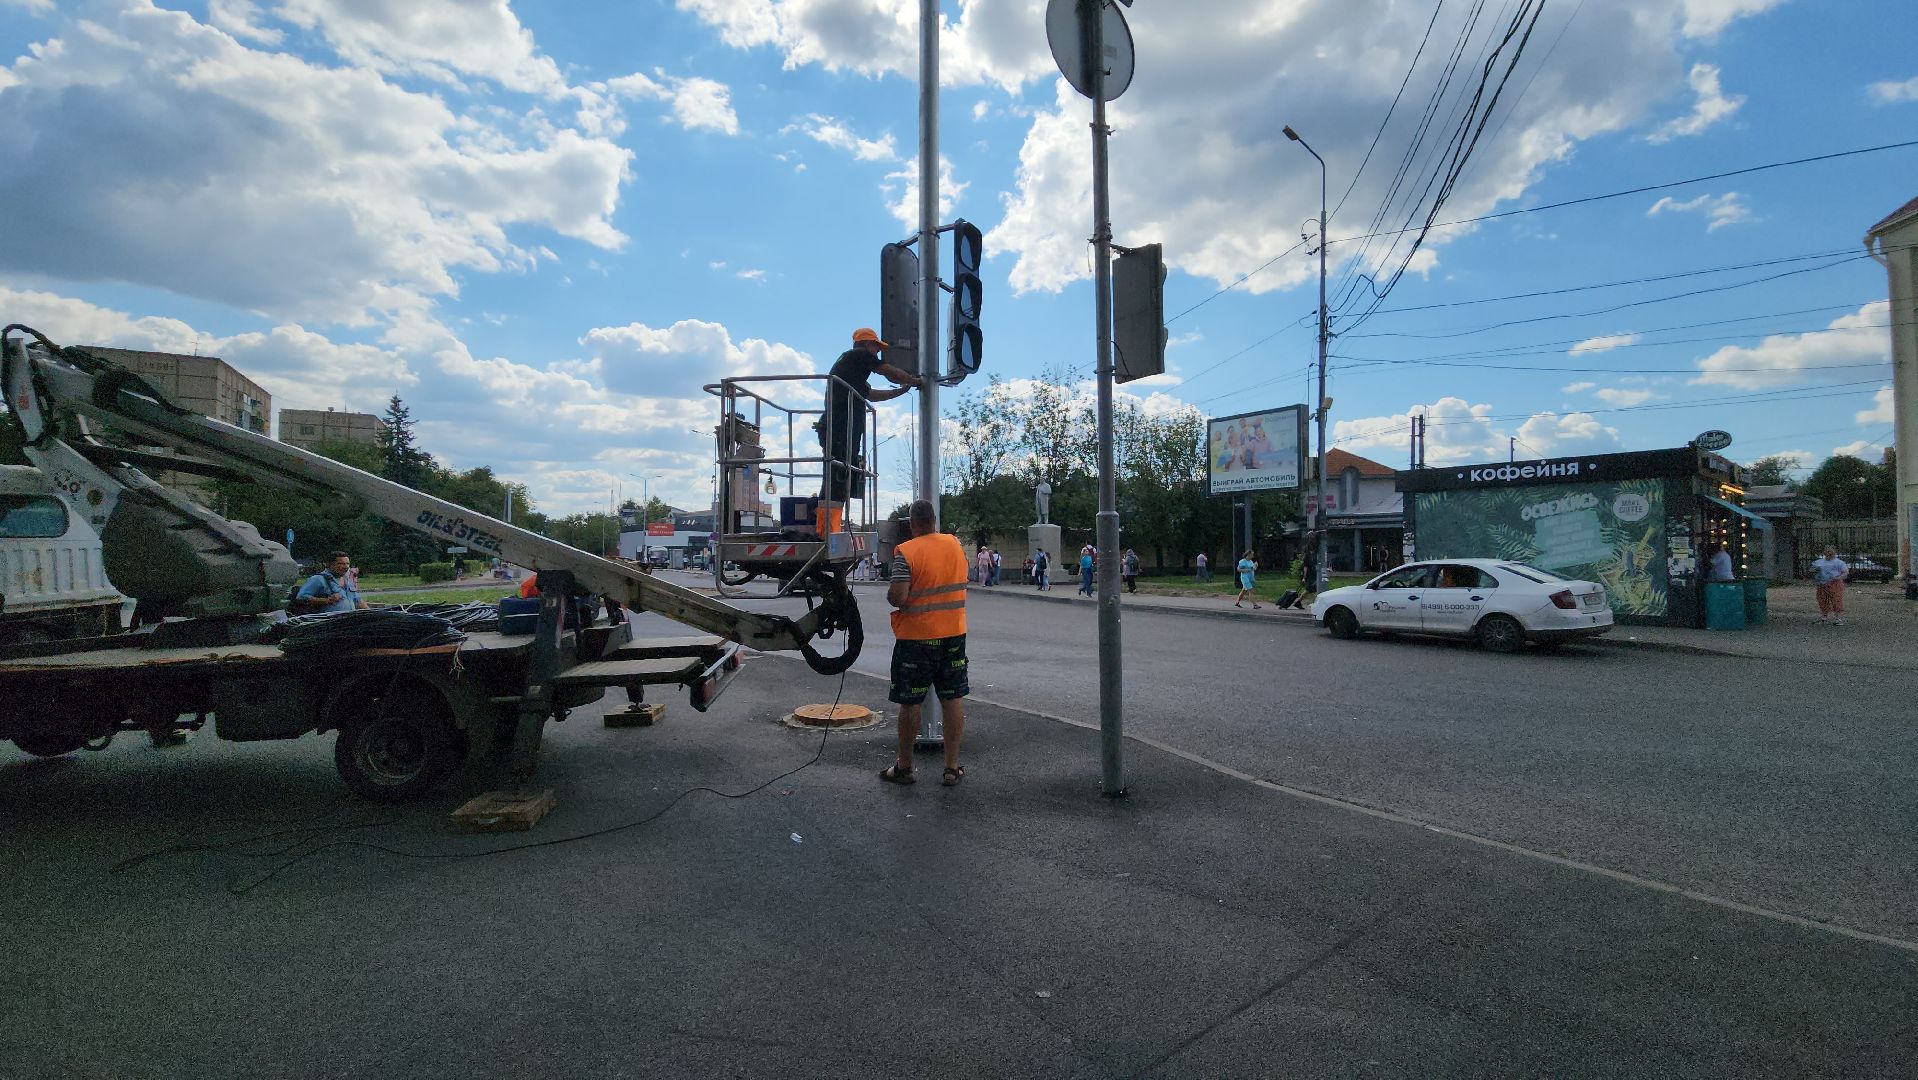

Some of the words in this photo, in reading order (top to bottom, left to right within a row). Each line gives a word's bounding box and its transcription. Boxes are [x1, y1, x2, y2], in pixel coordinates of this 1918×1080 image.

[1470, 460, 1579, 482] кофейня
[1212, 478, 1244, 487] ВЫИГРАЙ
[1245, 474, 1296, 484] АВТОМОБИЛЬ
